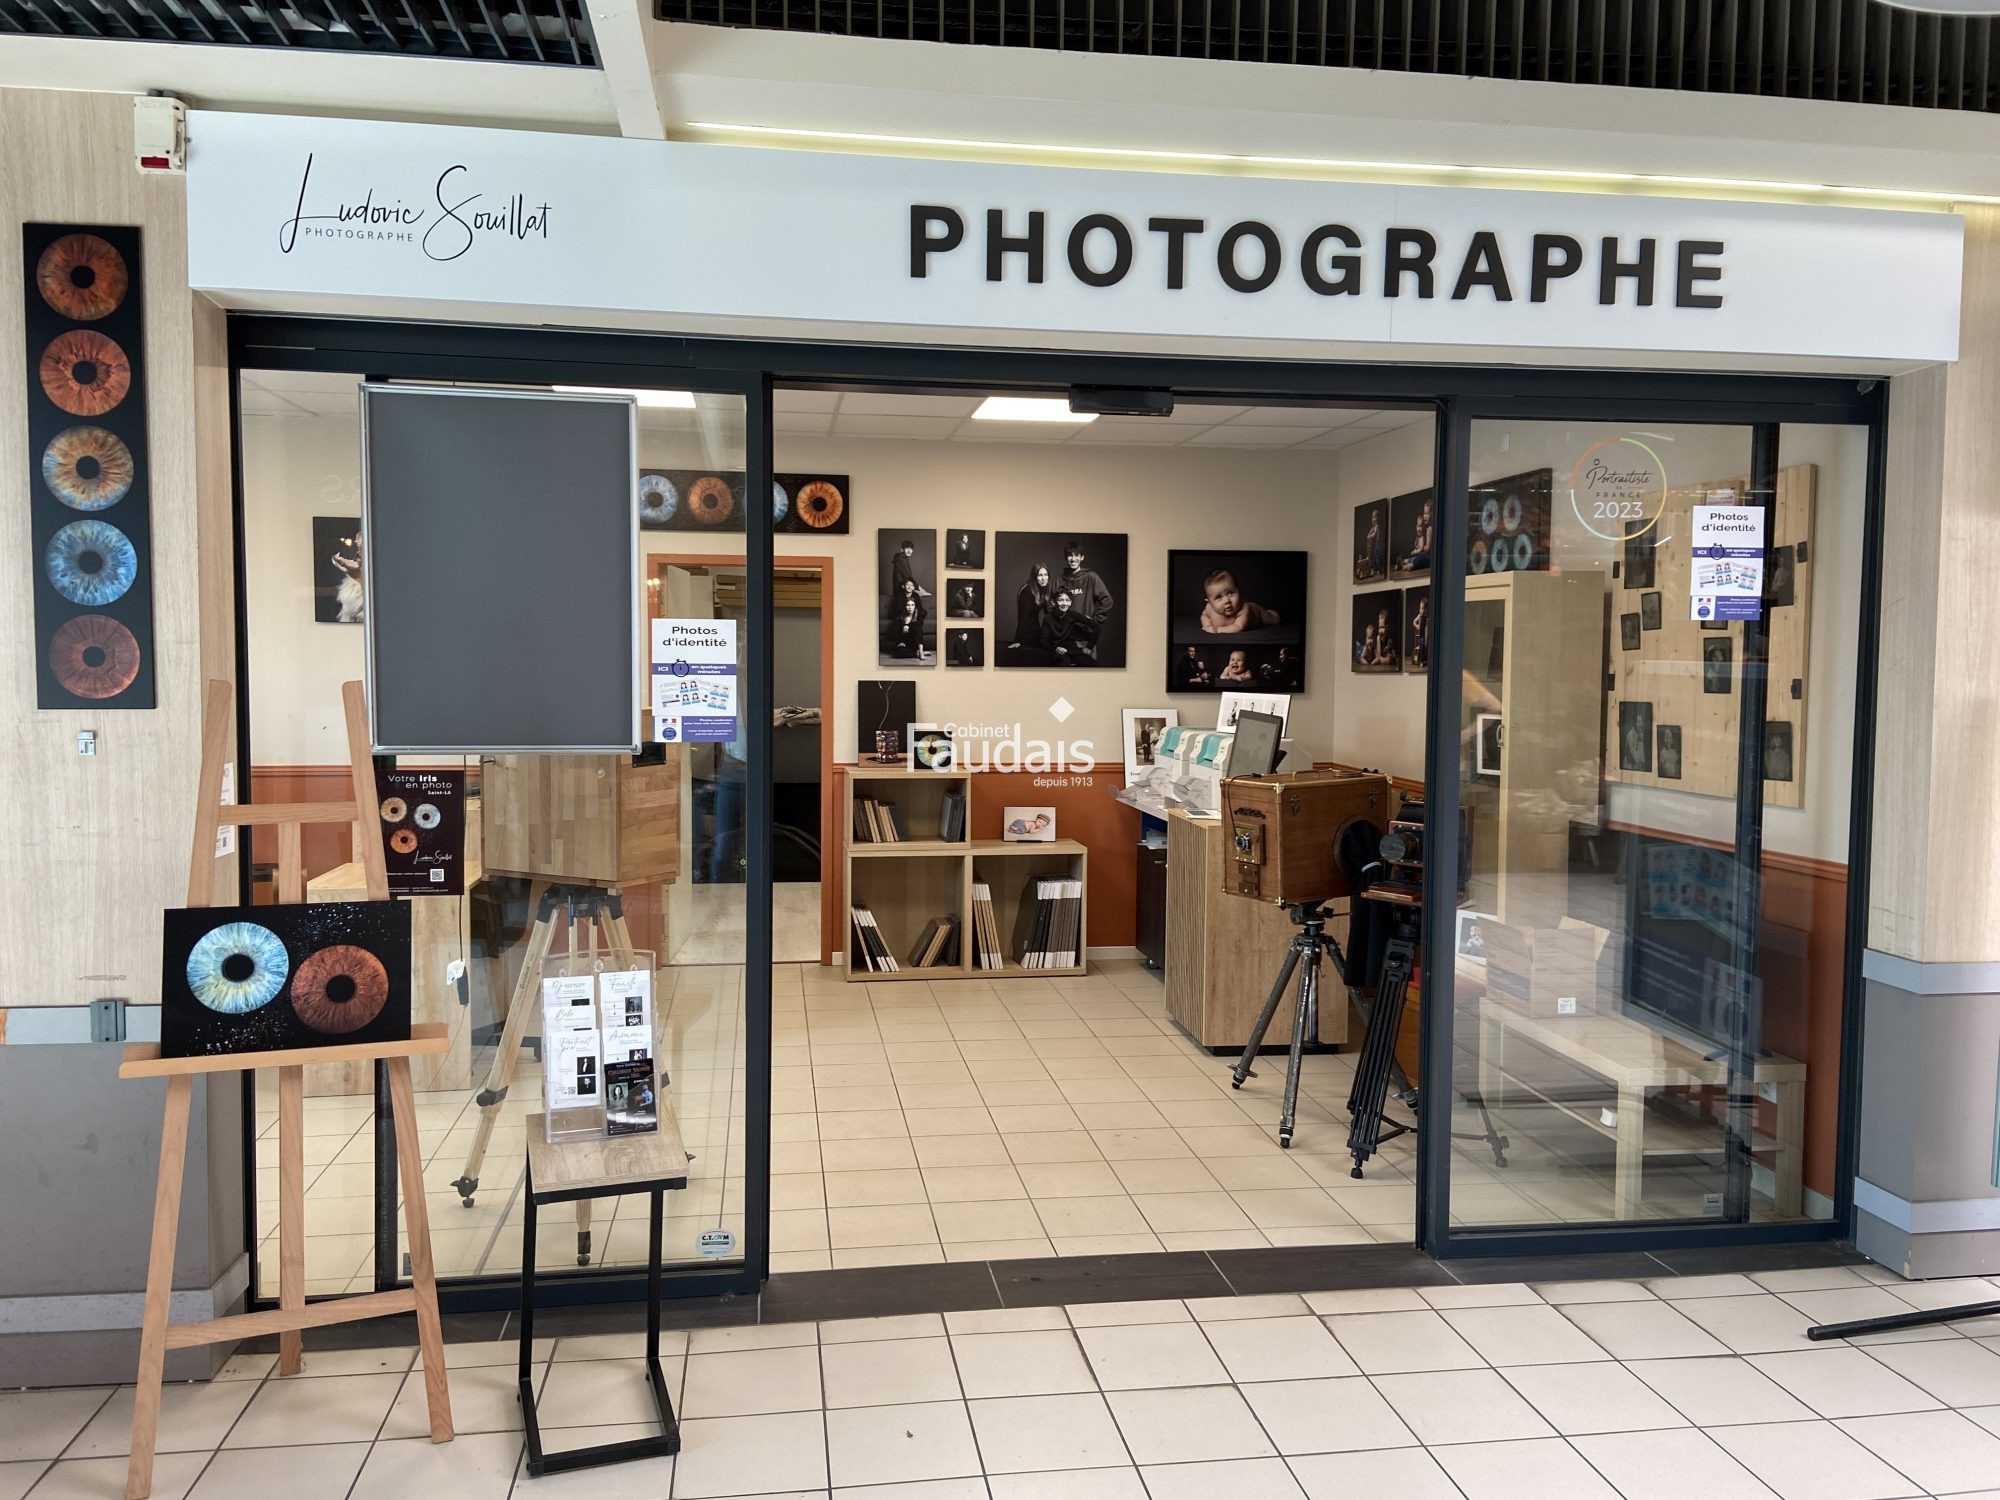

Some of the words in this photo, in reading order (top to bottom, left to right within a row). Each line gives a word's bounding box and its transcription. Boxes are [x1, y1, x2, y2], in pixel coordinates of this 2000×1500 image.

[279, 152, 425, 253] Ludovic
[422, 165, 552, 261] Souillat
[304, 226, 414, 243] PHOTOGRAPHE
[909, 204, 1725, 309] PHOTOGRAPHE
[1586, 465, 1653, 490] Portraitiste
[1593, 501, 1643, 519] 2023
[1710, 512, 1749, 521] Photos
[1701, 523, 1756, 532] d'identité
[672, 626, 718, 635] Photos
[662, 638, 727, 647] d'identité
[388, 775, 416, 783] Votre
[422, 782, 453, 790] photo
